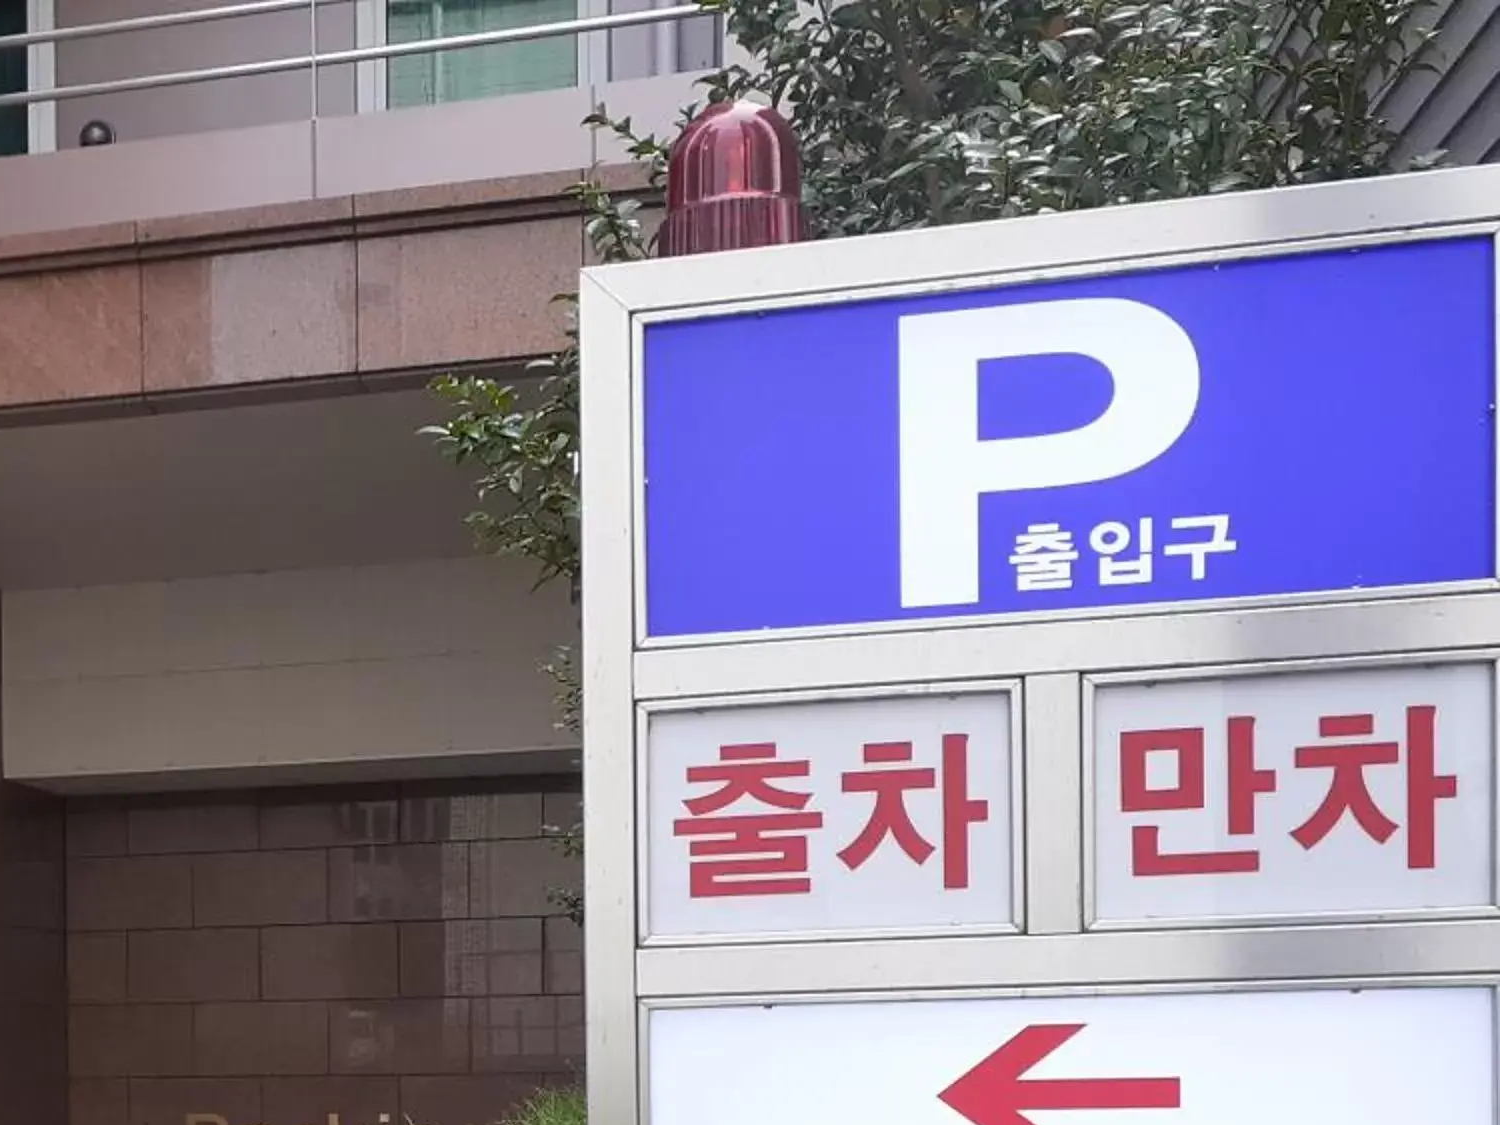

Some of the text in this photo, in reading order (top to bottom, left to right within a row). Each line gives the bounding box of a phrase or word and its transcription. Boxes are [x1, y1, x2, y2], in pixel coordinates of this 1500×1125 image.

[898, 298, 1201, 609] P
[1008, 513, 1238, 592] 출입구
[673, 733, 989, 899] 출차
[1120, 704, 1458, 877] 만차
